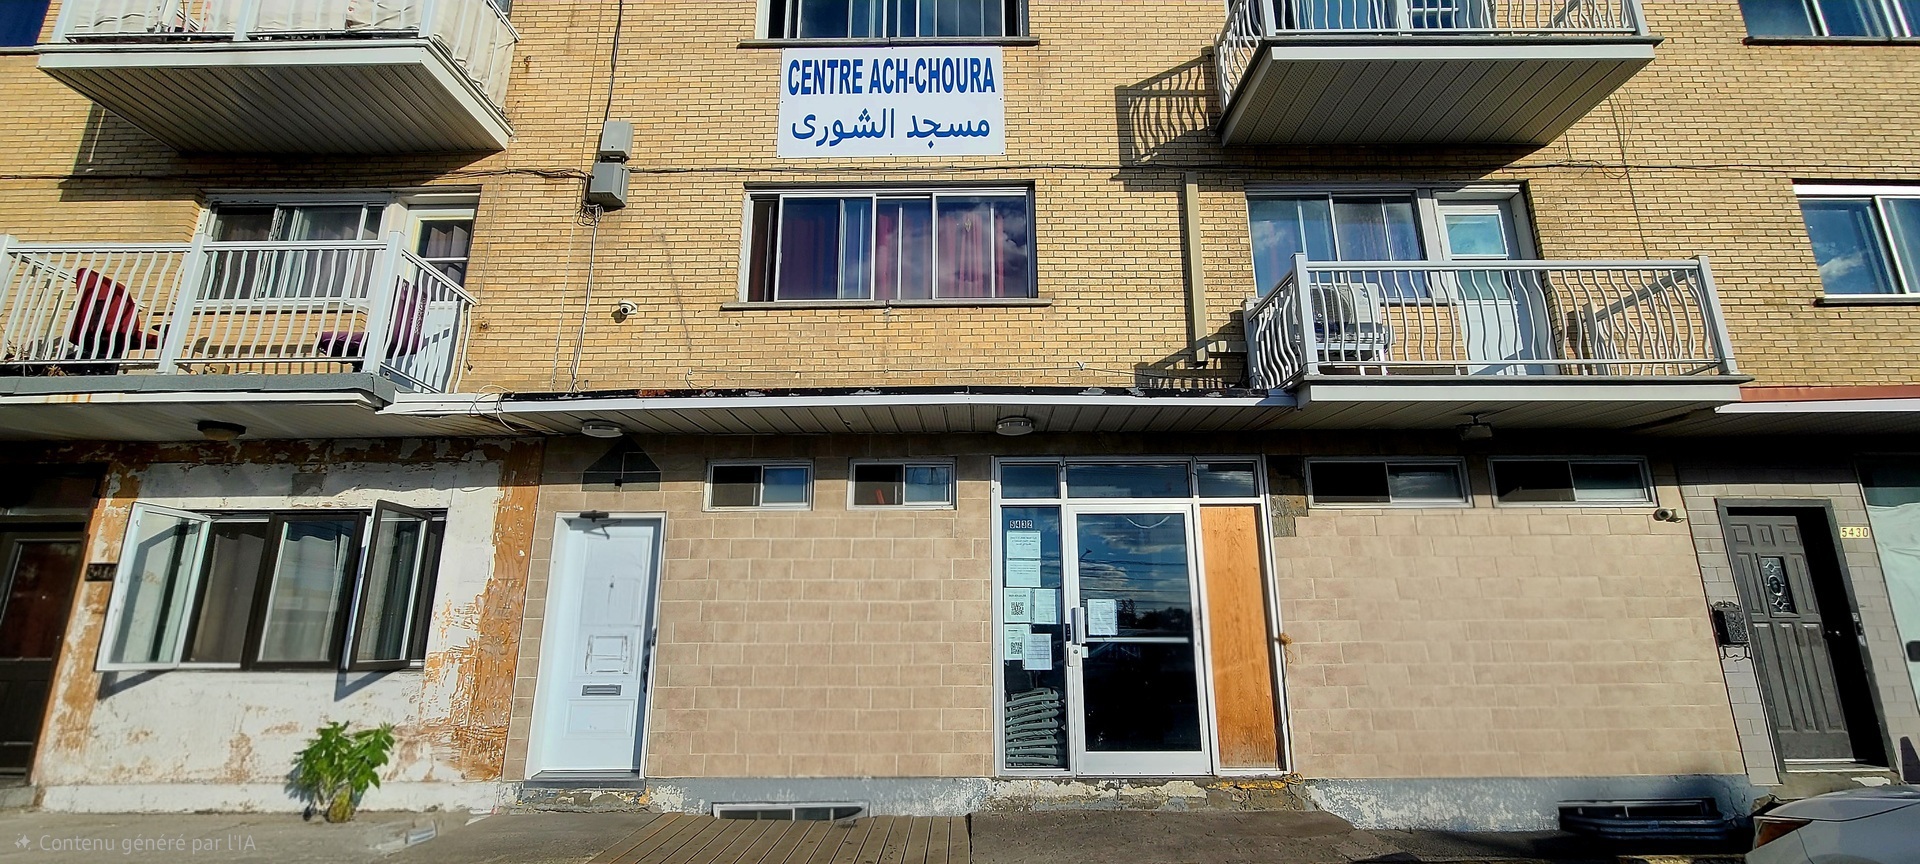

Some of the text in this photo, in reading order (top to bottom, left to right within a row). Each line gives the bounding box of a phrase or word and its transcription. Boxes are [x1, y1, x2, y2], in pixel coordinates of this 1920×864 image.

[788, 57, 996, 95] CENTRE ACH-CHOURA
[791, 107, 990, 149] مسجد الشورى
[1009, 519, 1033, 529] 5432
[1841, 527, 1869, 538] 5430
